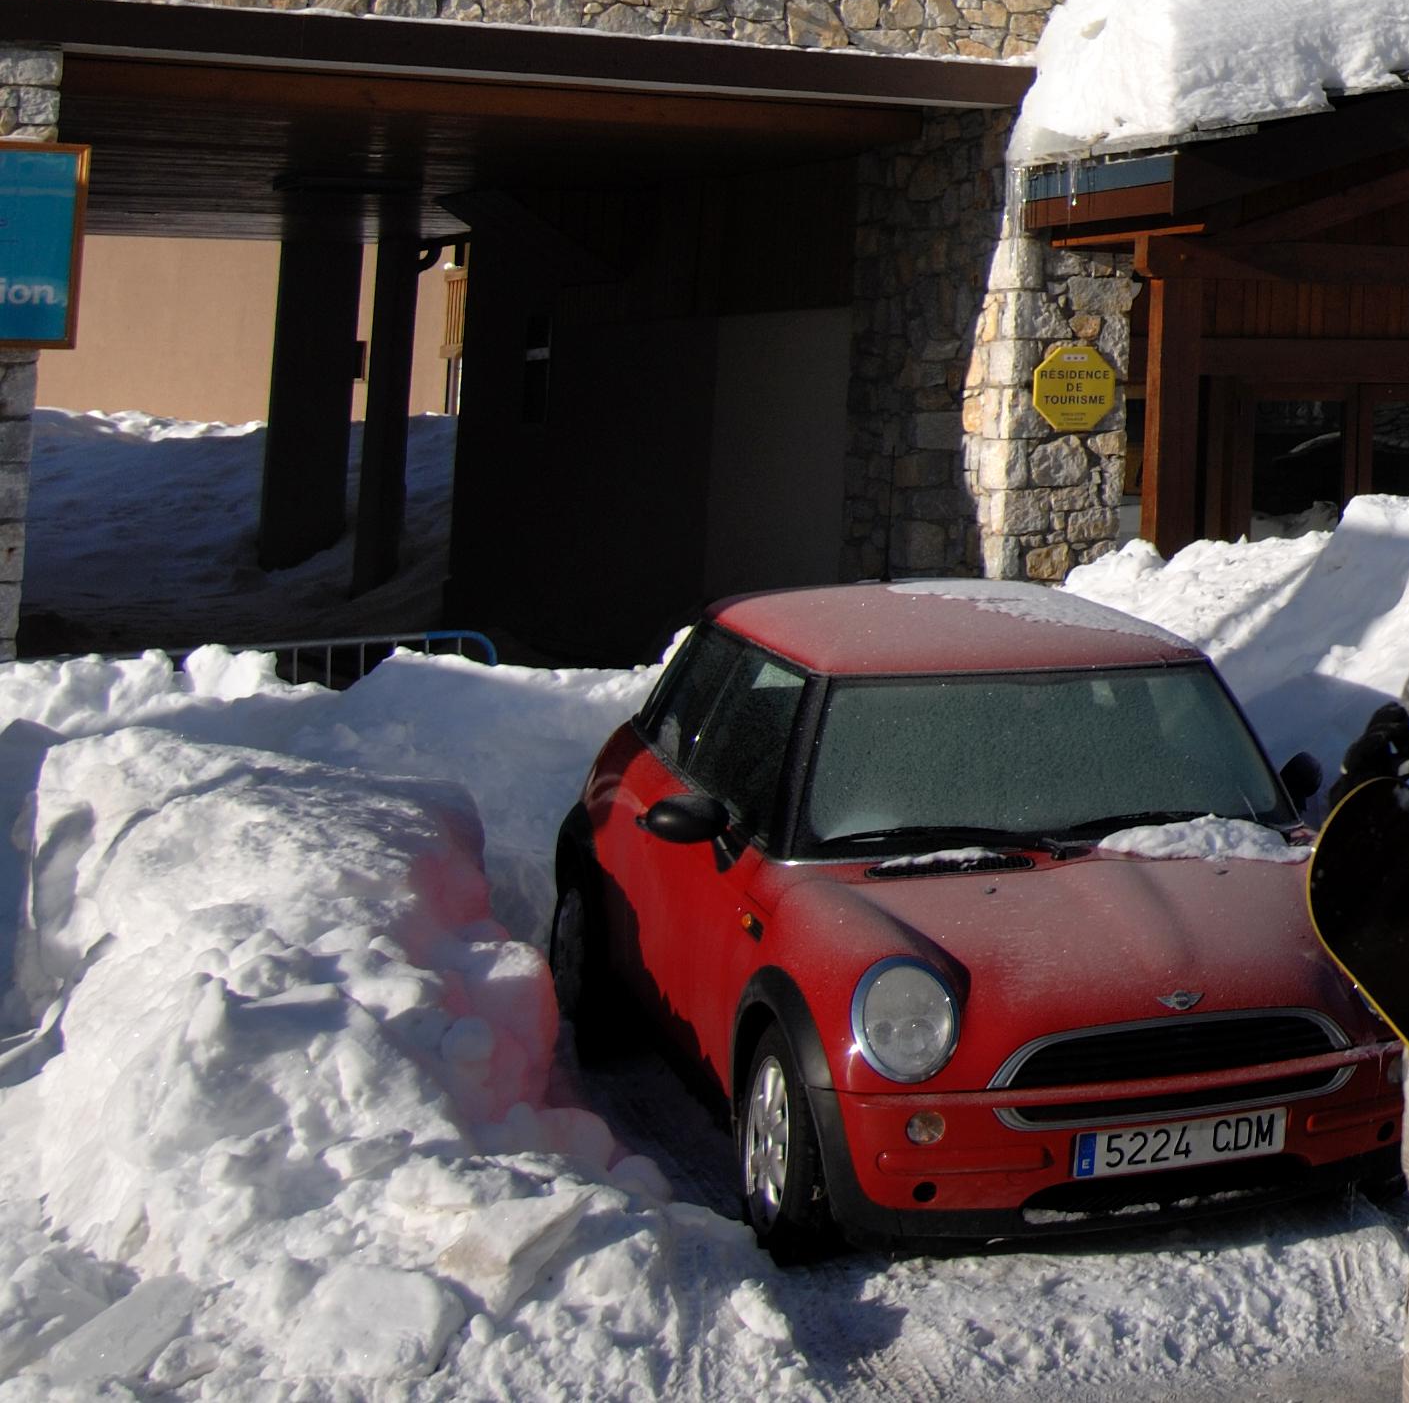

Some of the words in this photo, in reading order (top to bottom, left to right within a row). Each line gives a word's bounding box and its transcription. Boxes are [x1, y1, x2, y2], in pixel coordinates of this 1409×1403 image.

[1067, 383, 1083, 392] DE
[1044, 396, 1105, 405] TOURISME
[1106, 1125, 1192, 1168] 5224
[1212, 1114, 1275, 1153] CDM
